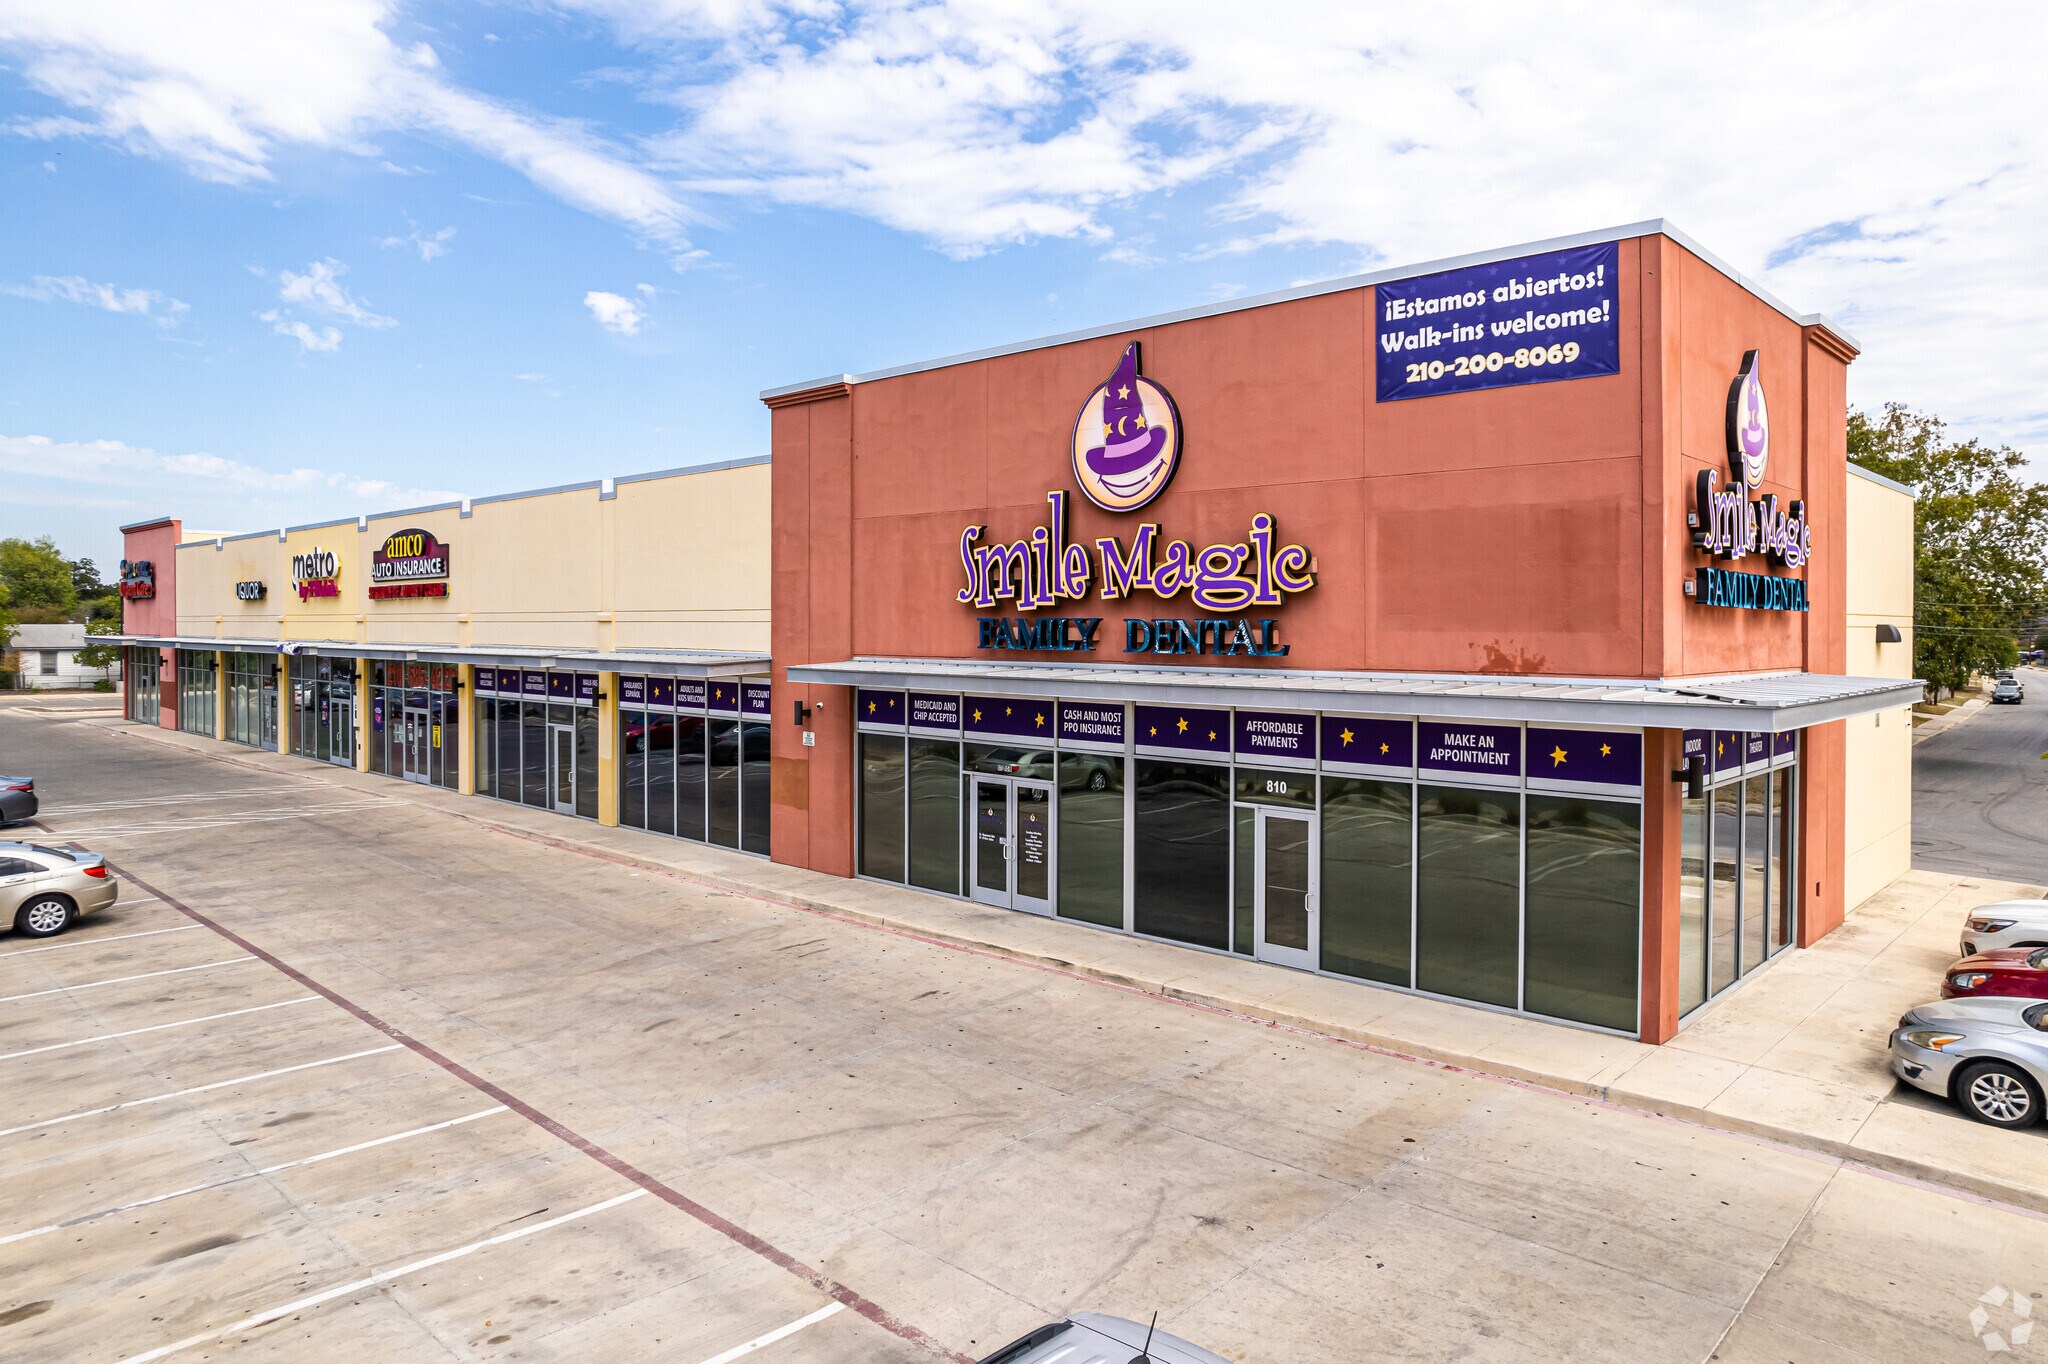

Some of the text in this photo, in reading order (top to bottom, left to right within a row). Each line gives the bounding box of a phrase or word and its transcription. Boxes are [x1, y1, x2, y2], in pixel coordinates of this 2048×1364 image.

[1385, 264, 1605, 322] ¡Estamos abiertos!
[1381, 299, 1611, 354] Walk-ins welcome!
[1405, 341, 1581, 384] 210-200-8069
[1703, 452, 1812, 569] Smile Magic
[386, 534, 423, 558] amco
[955, 489, 1316, 613] Smile Magic
[292, 546, 337, 580] metro
[372, 557, 442, 578] AUTO INSURANCE
[236, 581, 260, 600] LIQUOR
[1706, 567, 1810, 612] FAMILY DENTAL
[976, 616, 1291, 658] FAMILY DENTAL
[623, 681, 643, 690] HABLAMOS
[680, 685, 704, 694] ADULTS AND
[625, 689, 641, 698] ESPAÑOL
[677, 693, 706, 703] KIDS WELCOME
[747, 689, 770, 699] DISCOUNT
[752, 699, 765, 708] PLAN
[914, 700, 957, 712] MEDICAID AND
[913, 710, 957, 723] CHIP ACCEPTED
[1063, 709, 1122, 723] CASH AND MOST
[1063, 722, 1122, 736] PPO INSURANCE
[1246, 720, 1303, 735] AFFORDABLE
[1251, 734, 1298, 749] PAYMENTS
[1444, 733, 1494, 748] MAKE AN
[1685, 739, 1702, 753] INDOOR
[1749, 740, 1763, 754] THEATER
[1430, 748, 1510, 766] APPOINTMENT
[1266, 780, 1287, 794] 810
